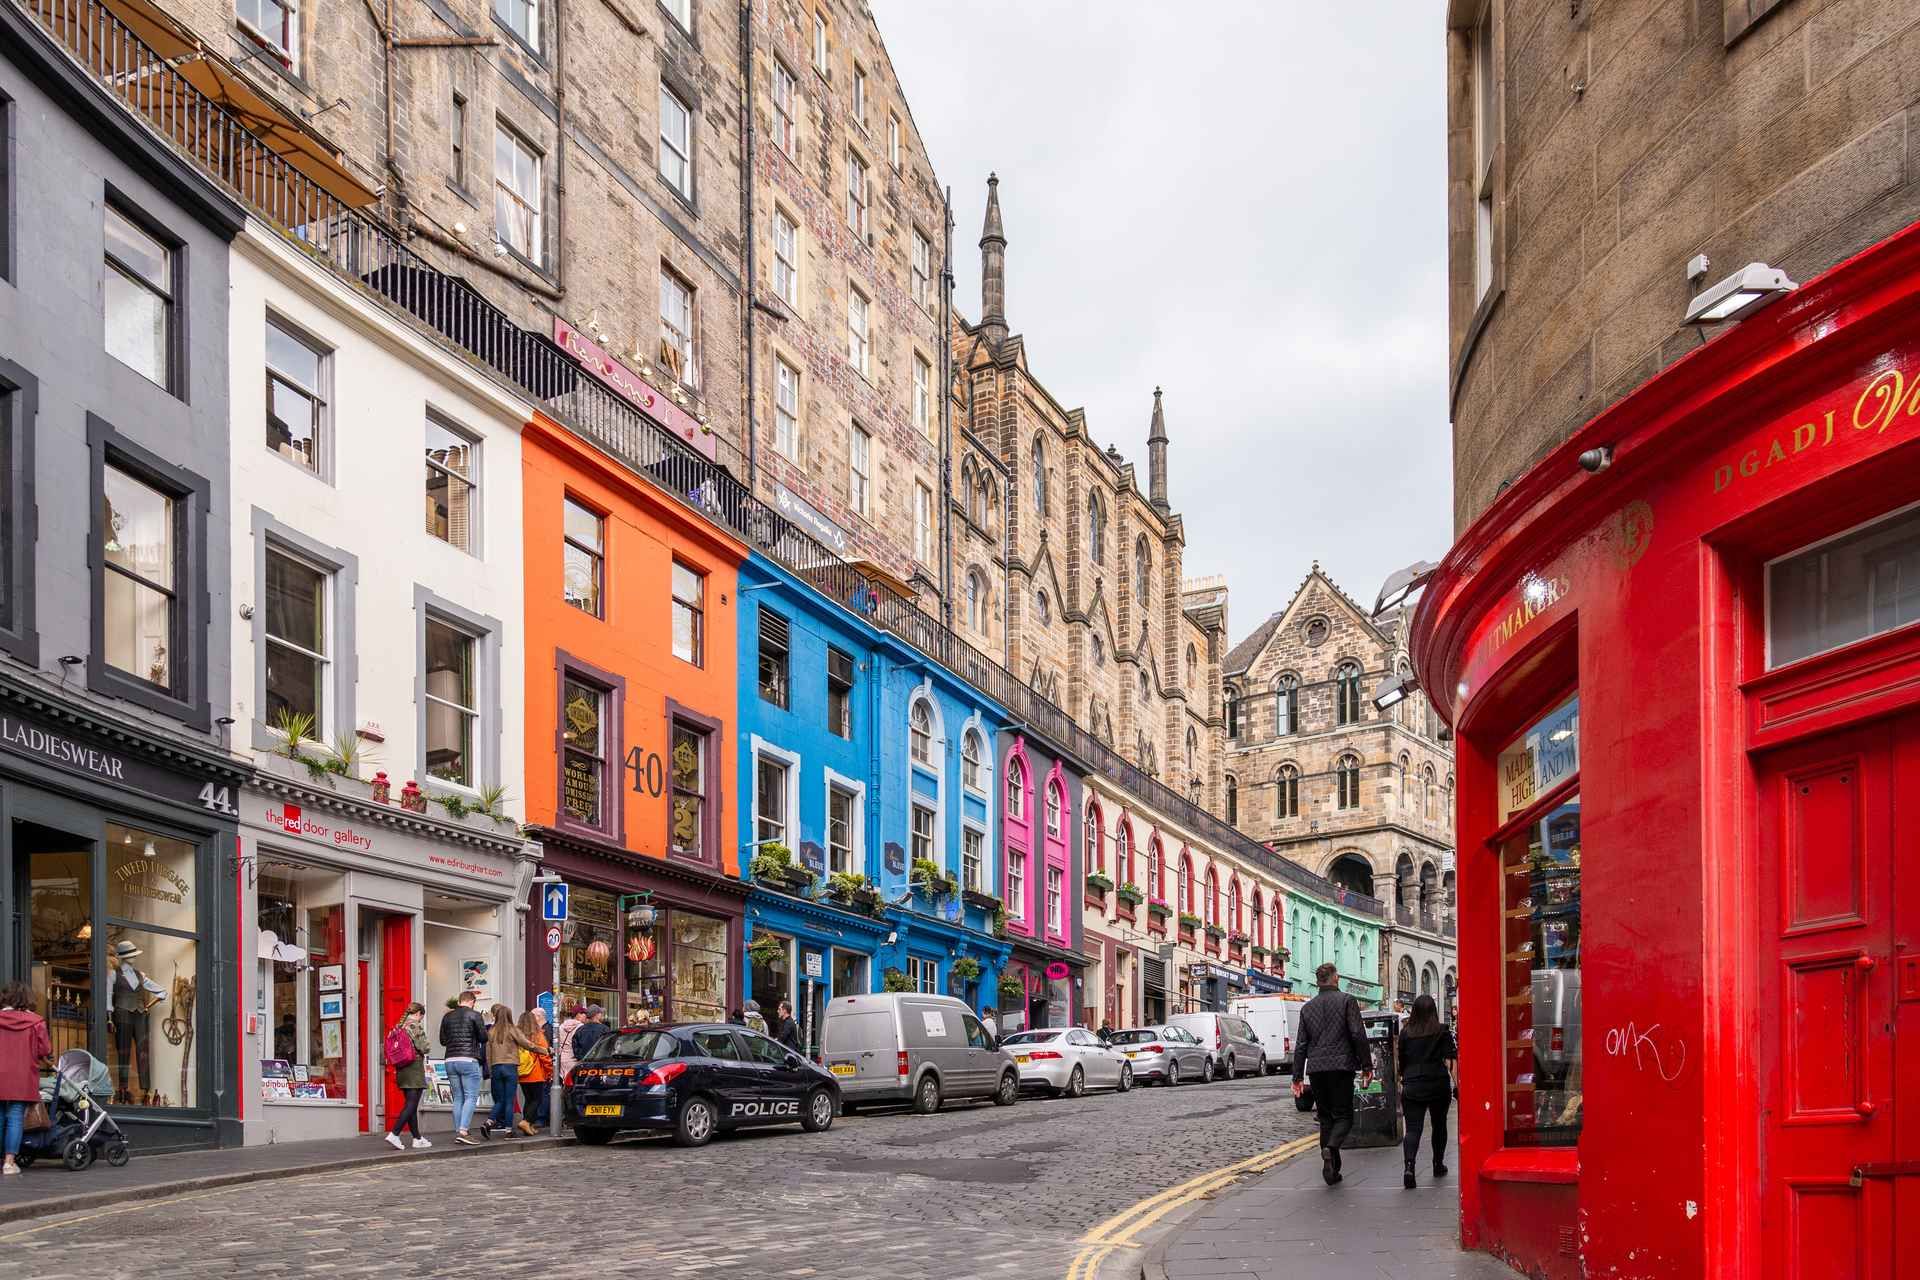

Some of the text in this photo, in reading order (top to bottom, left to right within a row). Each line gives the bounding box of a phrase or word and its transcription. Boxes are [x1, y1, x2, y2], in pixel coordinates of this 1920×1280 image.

[2, 718, 124, 780] LADIESWEAR
[624, 745, 663, 798] 40
[1505, 747, 1534, 787] MADE
[564, 779, 595, 795] AMOUS
[265, 808, 372, 850] the red door gallery
[114, 860, 148, 881] TWEED
[428, 855, 503, 878] www.edinburghart.com
[548, 933, 560, 946] 20
[578, 1068, 635, 1077] POLICE
[731, 1101, 799, 1117] POLICE
